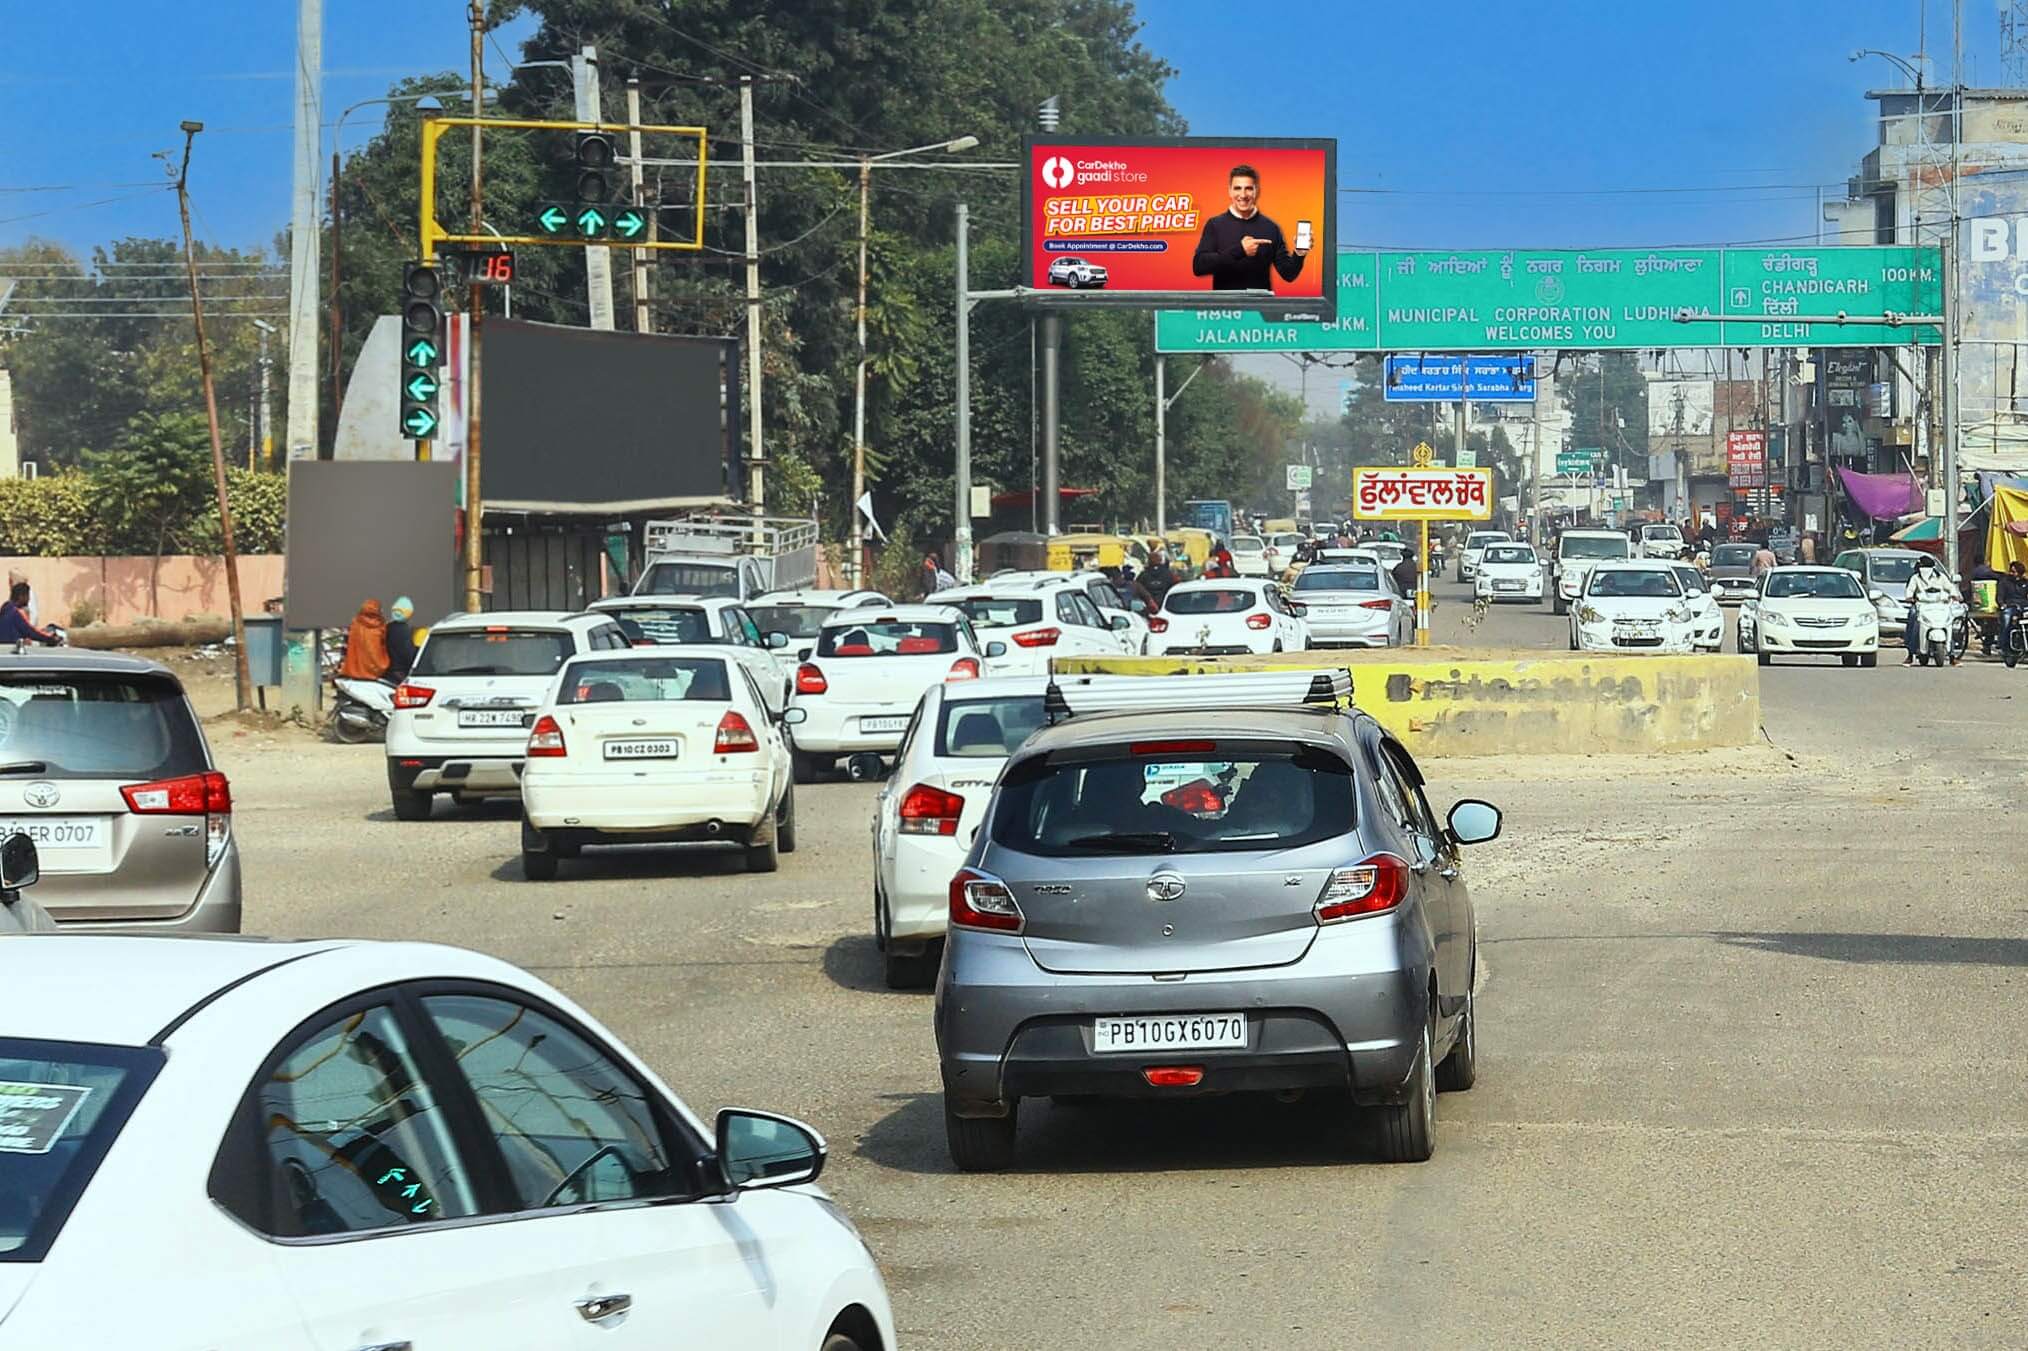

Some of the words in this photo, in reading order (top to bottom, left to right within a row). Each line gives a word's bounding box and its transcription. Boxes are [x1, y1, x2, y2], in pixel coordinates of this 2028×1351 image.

[1077, 160, 1127, 170] CarDekho
[1047, 199, 1093, 215] SELL
[1096, 197, 1149, 213] YOUR
[1152, 196, 1190, 211] CAR
[1048, 217, 1087, 233] FOR
[1091, 215, 1138, 231] BEST
[1140, 213, 1196, 229] PRICE
[1067, 242, 1107, 250] Appointment
[487, 255, 512, 281] 16
[1526, 260, 1564, 273] ਨਗਰ
[1576, 255, 1622, 273] ਨਿਗਮ
[1633, 255, 1703, 276] ਲੁਧਿਆਣਾ
[1882, 268, 1907, 282] 100
[1761, 280, 1869, 294] CHANDIGARH
[1388, 308, 1479, 323] MUNICIPAL
[1494, 307, 1611, 322] CORPORATION
[1624, 306, 1711, 321] LUDHINA
[1342, 316, 1370, 331] KM.
[1761, 323, 1810, 338] DELHI
[1195, 328, 1298, 344] JALANDHAR
[1485, 326, 1574, 340] WELCOMES
[1583, 326, 1616, 340] YOU
[54, 825, 94, 842] 0707
[1111, 1018, 1242, 1045] PB10GX6070
